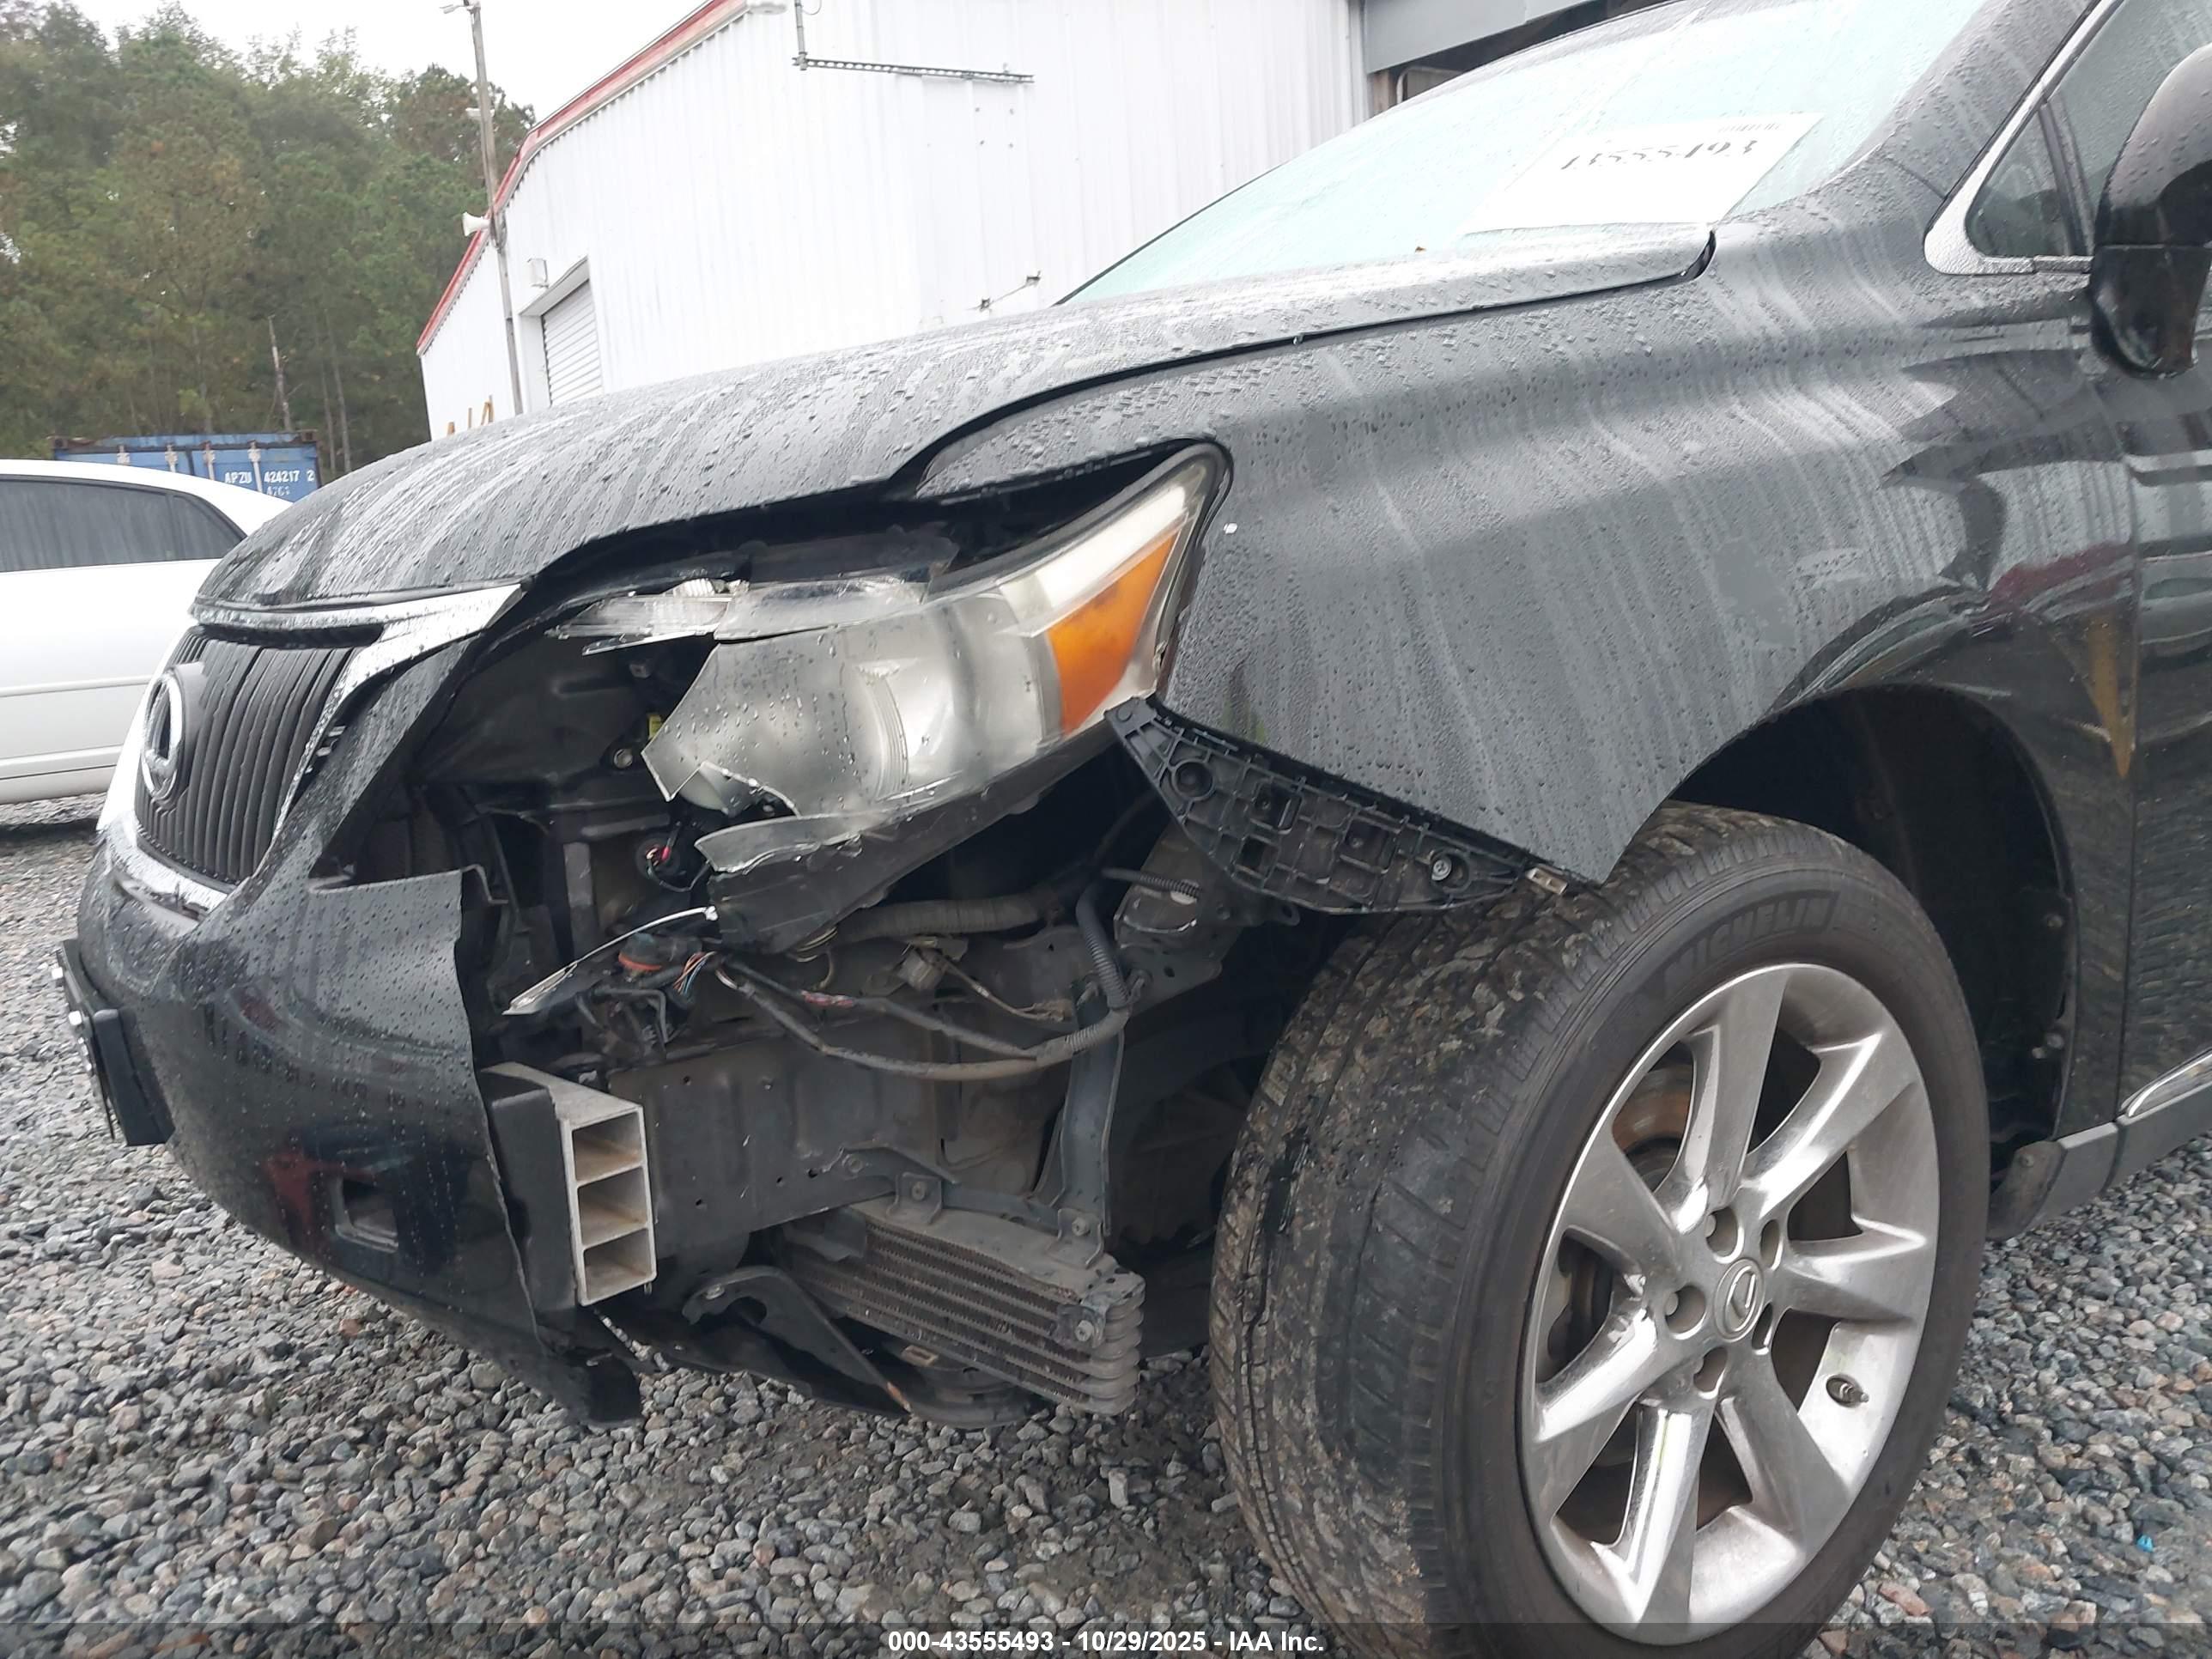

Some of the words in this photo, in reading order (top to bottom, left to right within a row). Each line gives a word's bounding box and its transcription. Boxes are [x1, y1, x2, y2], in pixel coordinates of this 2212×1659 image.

[225, 472, 252, 483] APZU
[264, 471, 301, 483] 424217
[307, 470, 315, 482] 2
[1662, 896, 1832, 996] MICHELIN
